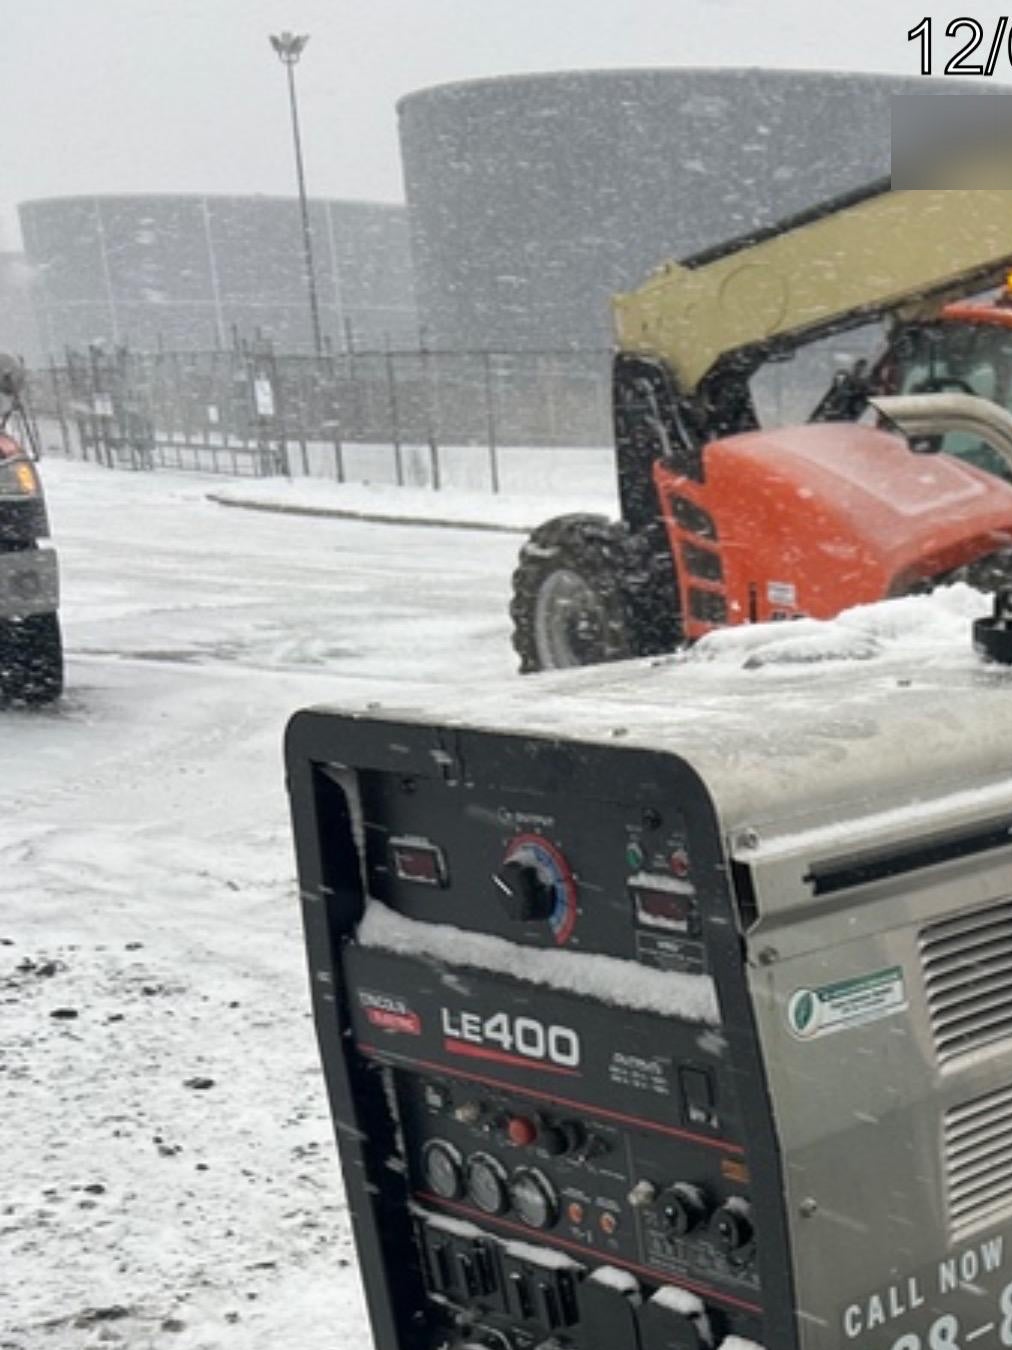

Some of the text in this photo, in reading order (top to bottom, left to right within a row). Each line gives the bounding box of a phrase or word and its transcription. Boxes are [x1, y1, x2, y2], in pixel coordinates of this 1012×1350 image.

[440, 1006, 581, 1068] LE400
[843, 1235, 1004, 1339] CALL NOW
